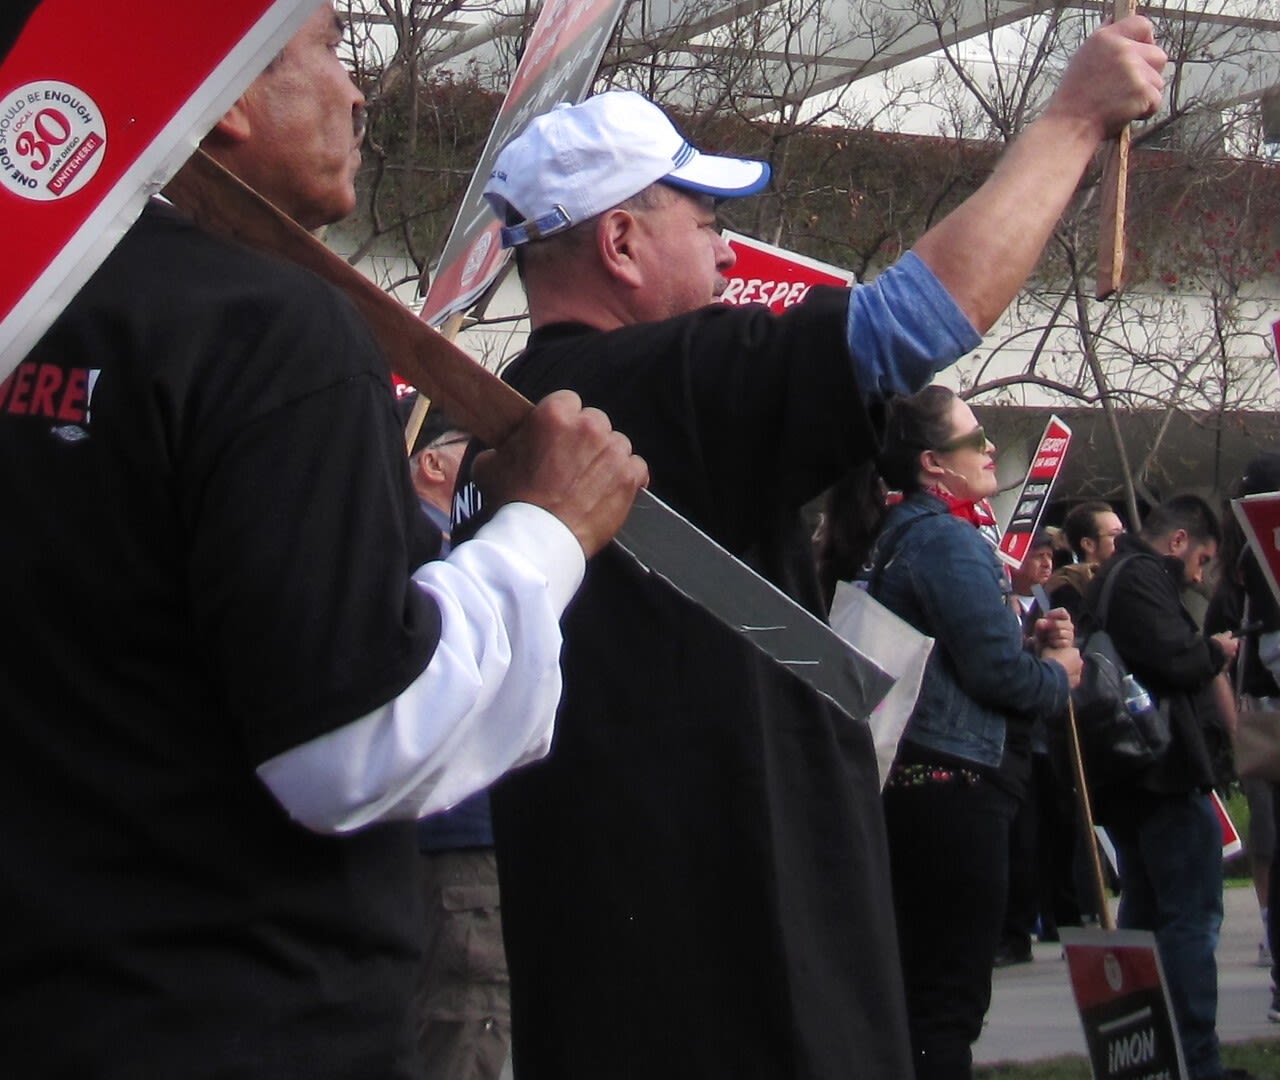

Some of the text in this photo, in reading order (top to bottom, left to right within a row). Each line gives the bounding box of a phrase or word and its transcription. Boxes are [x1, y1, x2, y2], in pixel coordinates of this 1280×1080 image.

[11, 169, 38, 189] ONE
[27, 91, 41, 104] BE
[44, 90, 93, 124] ENOUGH
[12, 111, 33, 133] LOCAL
[15, 107, 71, 170] 30
[49, 136, 80, 172] SAN DIEGO
[53, 138, 97, 189] UNITEHERE!
